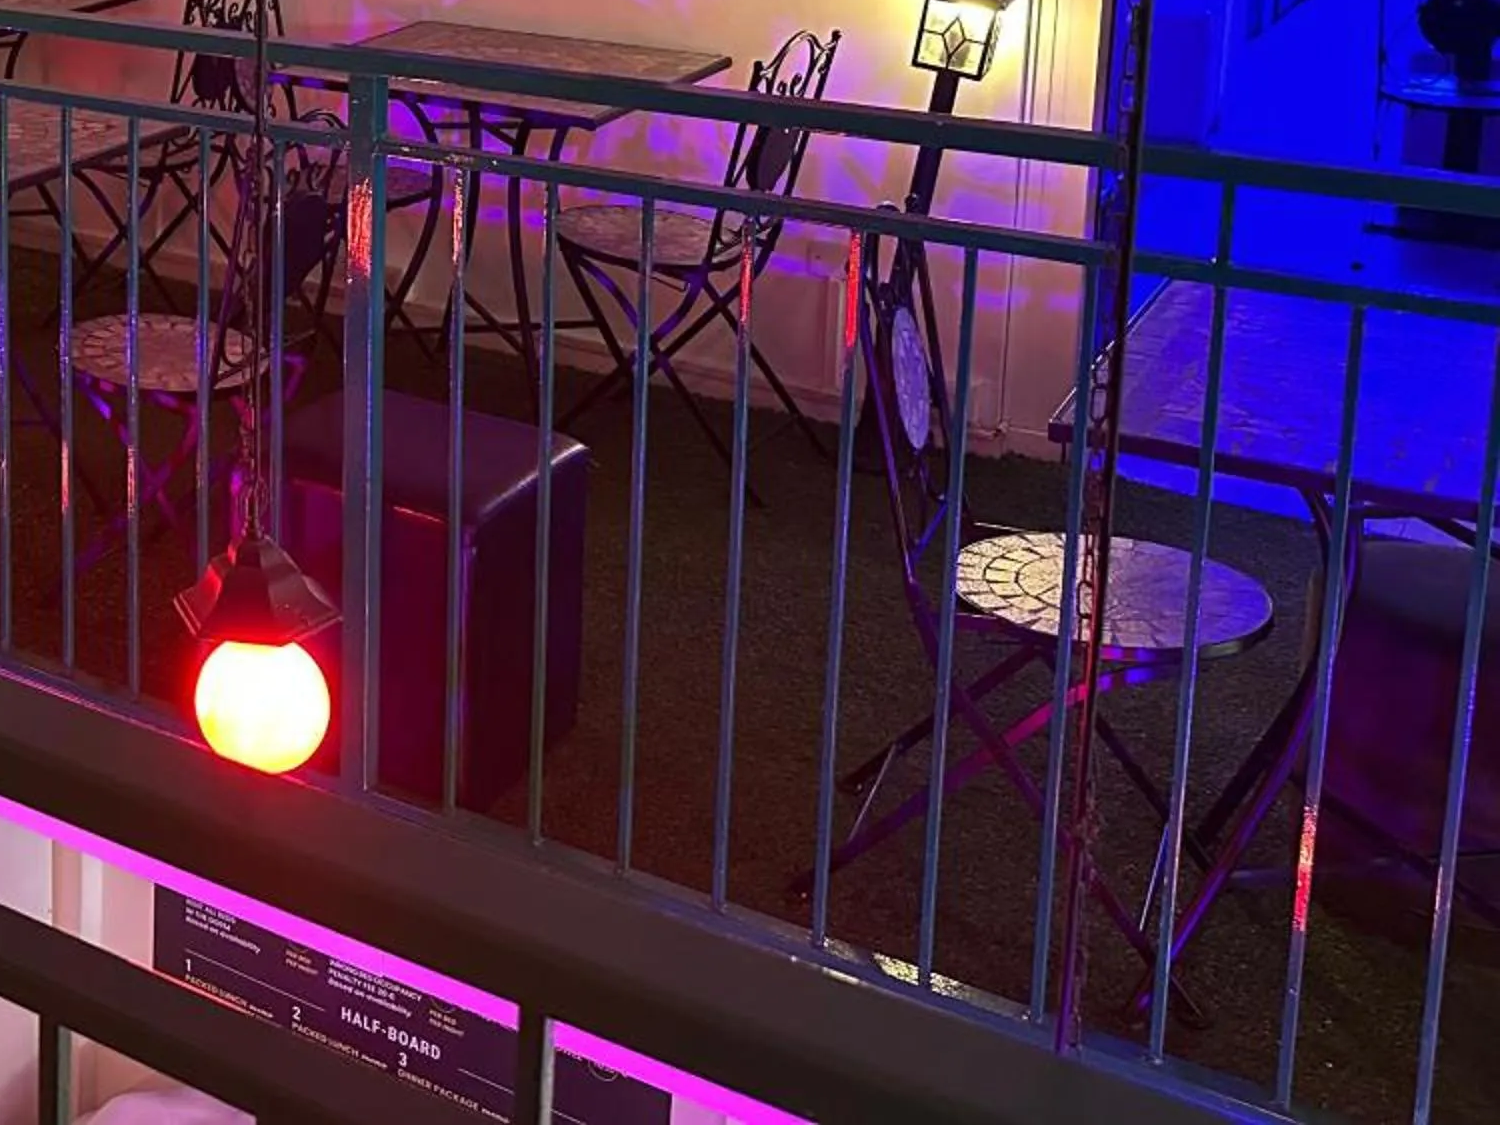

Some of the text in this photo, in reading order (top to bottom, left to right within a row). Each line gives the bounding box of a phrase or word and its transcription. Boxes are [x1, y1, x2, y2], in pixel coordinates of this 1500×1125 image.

[185, 958, 192, 972] 1
[291, 1006, 301, 1021] 2
[340, 1006, 442, 1060] HALF-BOARD
[398, 1052, 408, 1068] 3
